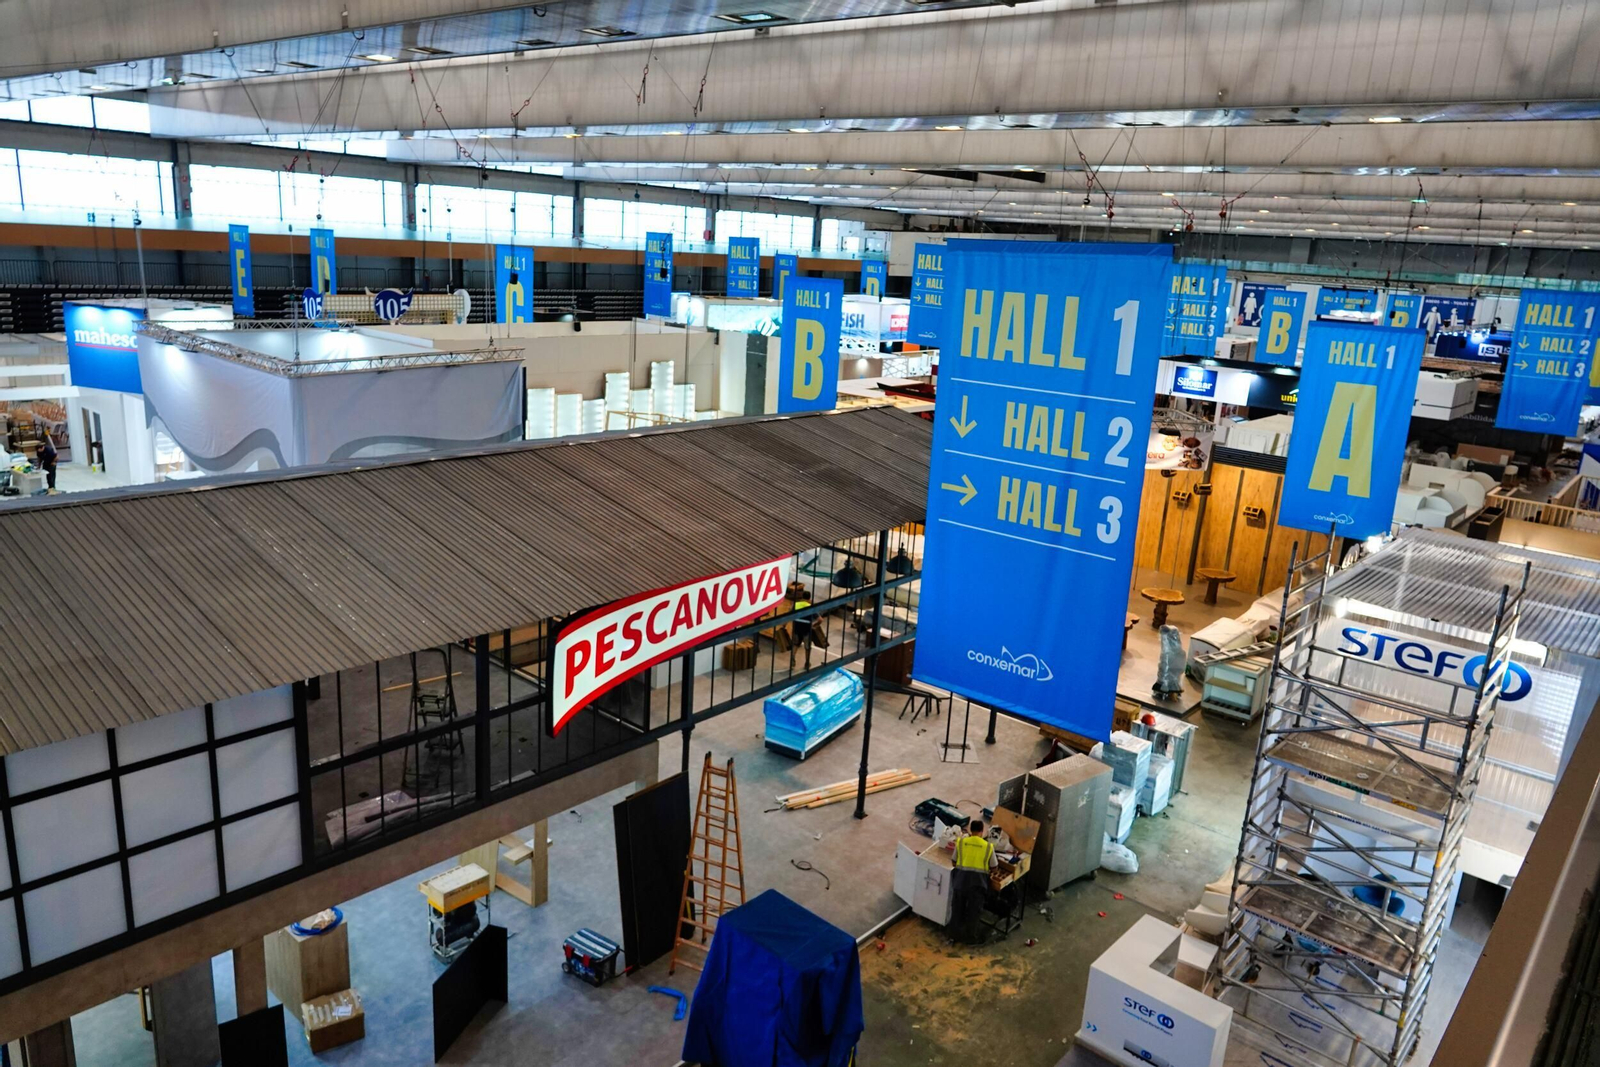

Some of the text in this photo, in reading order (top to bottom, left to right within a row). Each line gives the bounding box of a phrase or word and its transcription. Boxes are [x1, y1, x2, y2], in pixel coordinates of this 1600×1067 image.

[730, 246, 758, 260] HALL 1
[917, 254, 943, 271] HALL
[236, 249, 248, 297] E
[522, 258, 525, 271] 1
[738, 266, 757, 276] HALL 2
[738, 279, 757, 290] HALL 3
[926, 278, 943, 290] HALL
[1171, 276, 1219, 296] HALL 1
[303, 297, 322, 320] 105
[376, 297, 408, 320] 105
[795, 289, 830, 309] HALL 1
[925, 294, 942, 306] HALL
[1273, 296, 1297, 307] HALL 1
[1183, 303, 1218, 318] HALL 2
[1524, 304, 1595, 328] HALL 1
[960, 288, 1140, 376] HALL 1
[1181, 322, 1215, 337] HALL 3
[1266, 311, 1292, 355] B
[1328, 341, 1396, 369] HALL 1
[1540, 337, 1591, 355] HALL 2
[792, 318, 825, 401] B
[1536, 360, 1585, 378] HALL 3
[1003, 401, 1133, 468] HALL 2
[1308, 381, 1377, 498] A
[997, 475, 1123, 544] HALL 3
[565, 566, 782, 700] PESCANOVA
[967, 649, 1037, 679] conxemar
